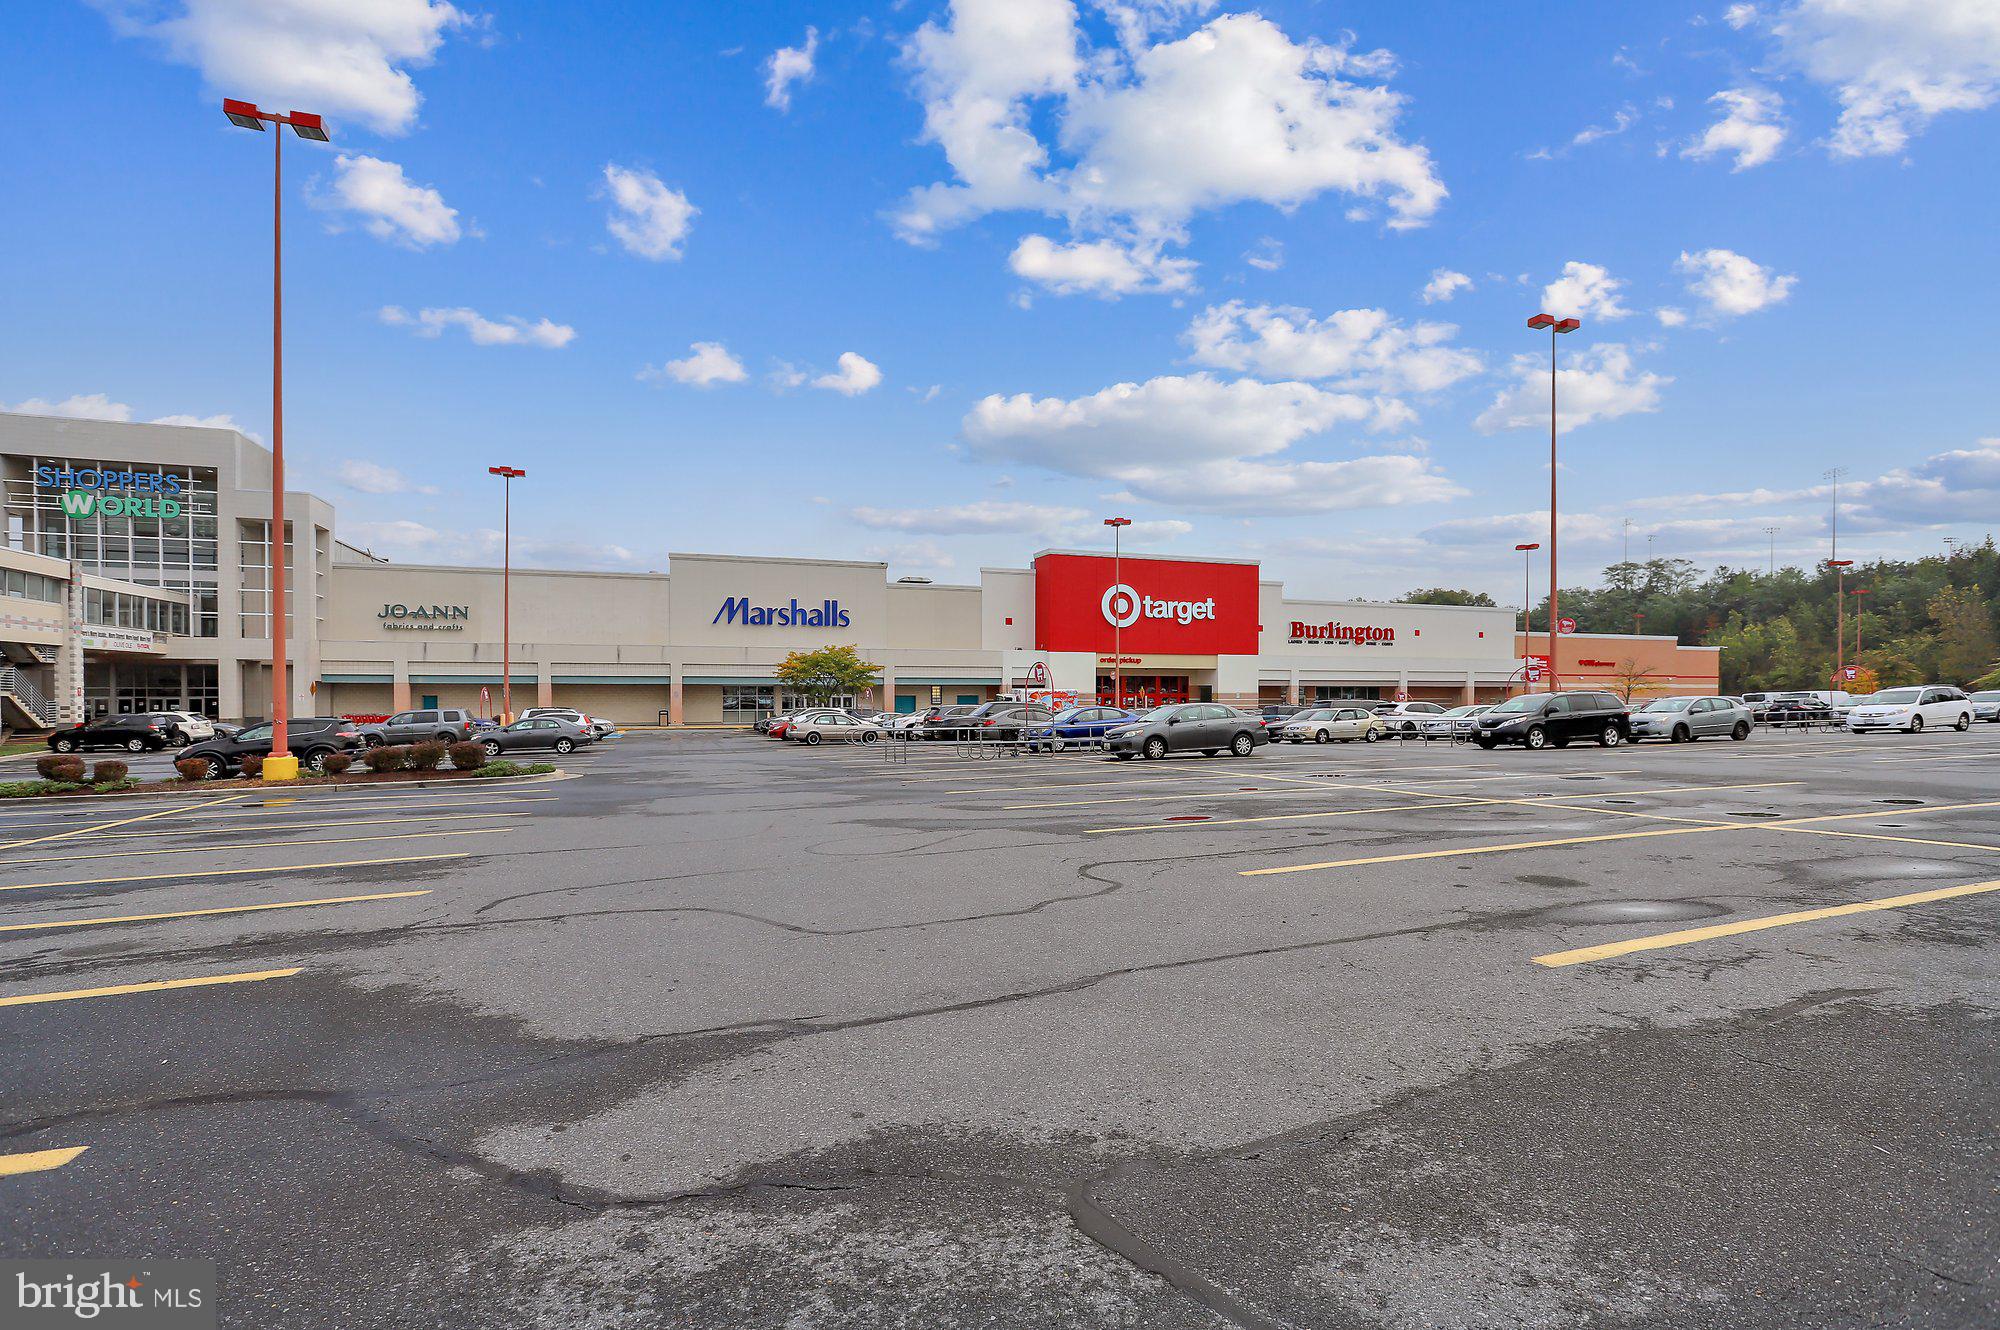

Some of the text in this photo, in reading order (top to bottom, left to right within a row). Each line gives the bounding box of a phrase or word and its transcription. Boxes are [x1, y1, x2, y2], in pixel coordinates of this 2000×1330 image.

[38, 466, 181, 494] SHOPPERS
[61, 490, 181, 519] WORLD
[712, 597, 850, 627] Marshalls
[1143, 596, 1215, 625] target
[383, 622, 414, 630] fabrics
[438, 623, 464, 631] crafts
[1289, 621, 1395, 646] Burlington
[1119, 656, 1142, 664] pickup
